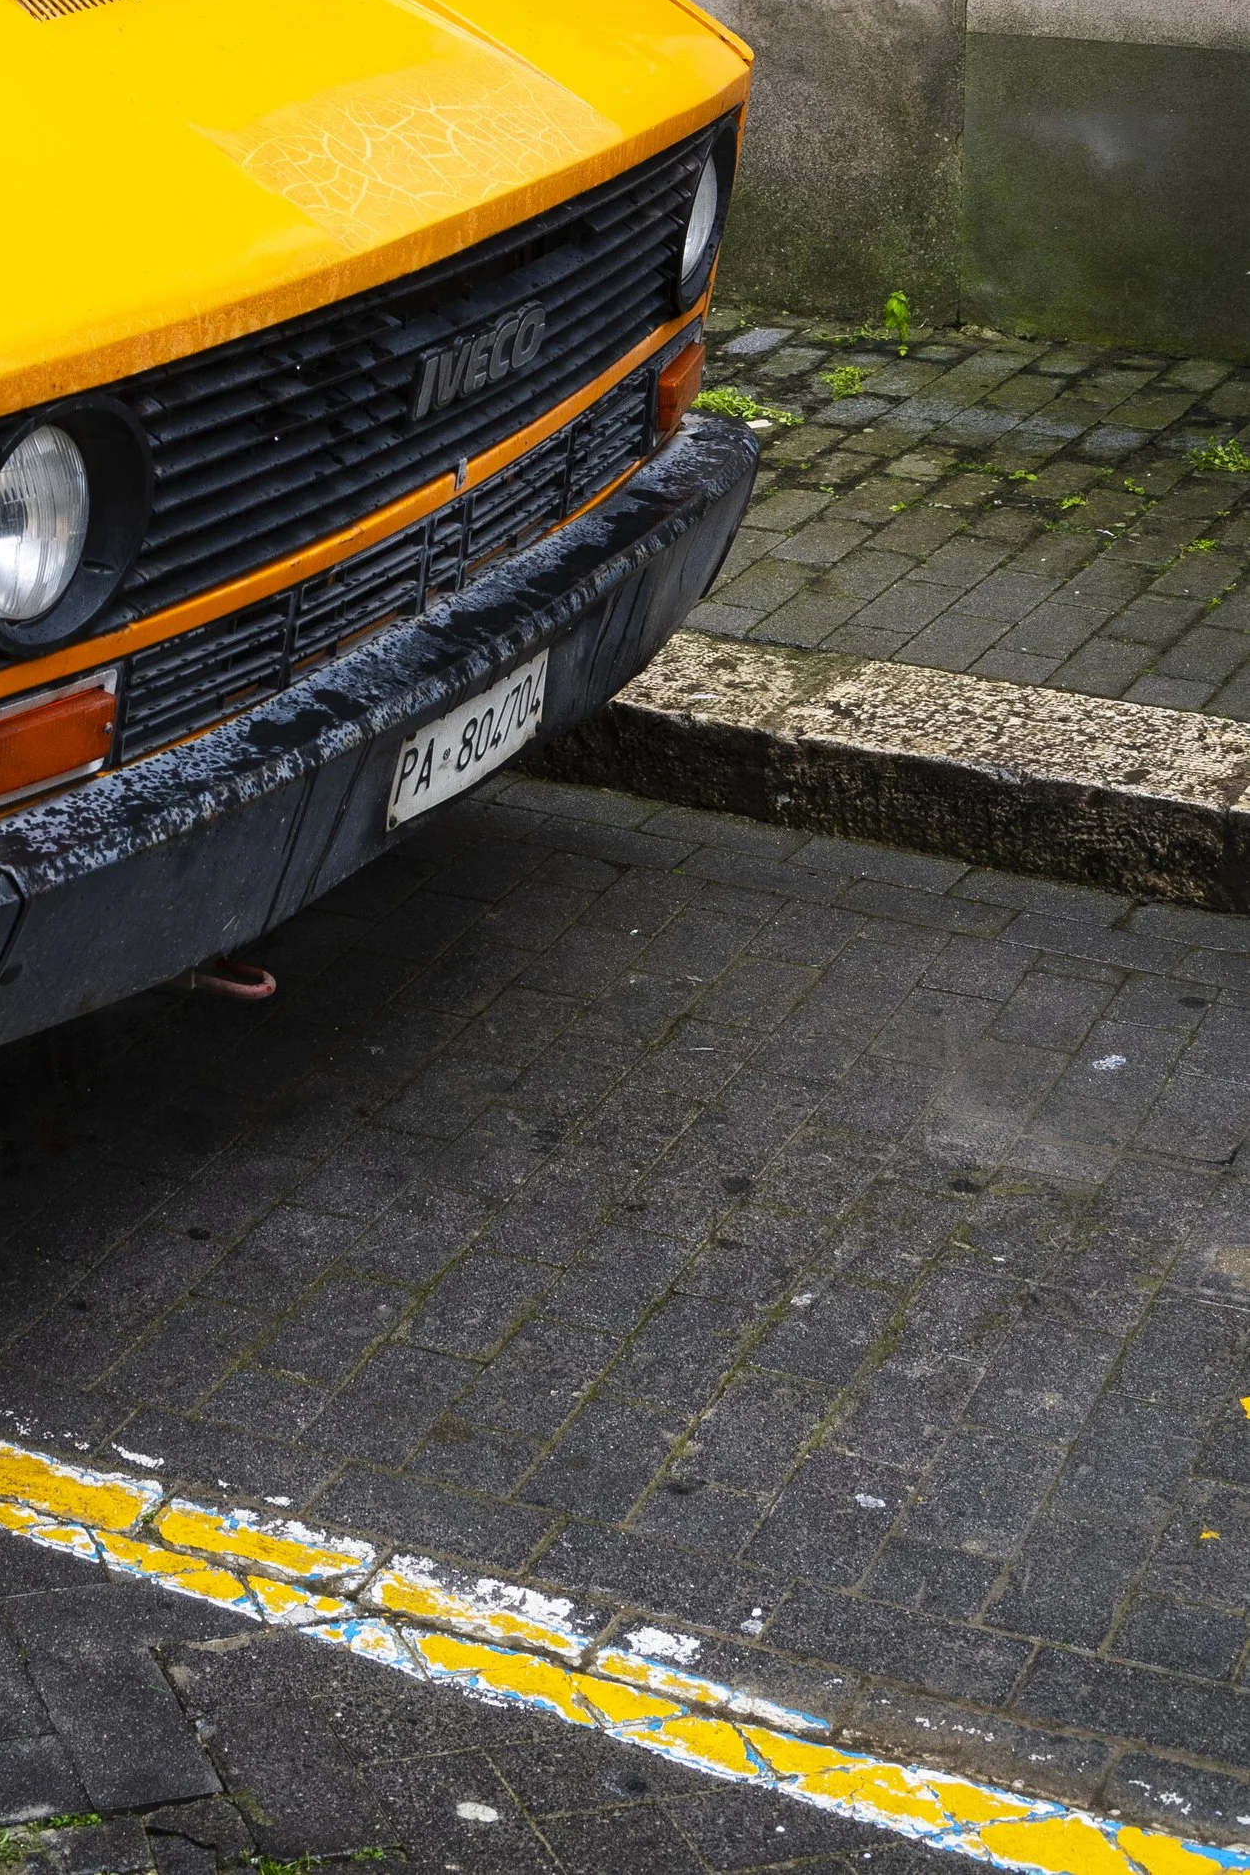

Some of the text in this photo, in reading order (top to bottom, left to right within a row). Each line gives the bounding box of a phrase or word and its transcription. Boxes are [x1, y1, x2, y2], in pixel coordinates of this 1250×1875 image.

[413, 303, 547, 420] IVECO
[393, 659, 546, 806] PA 804704
